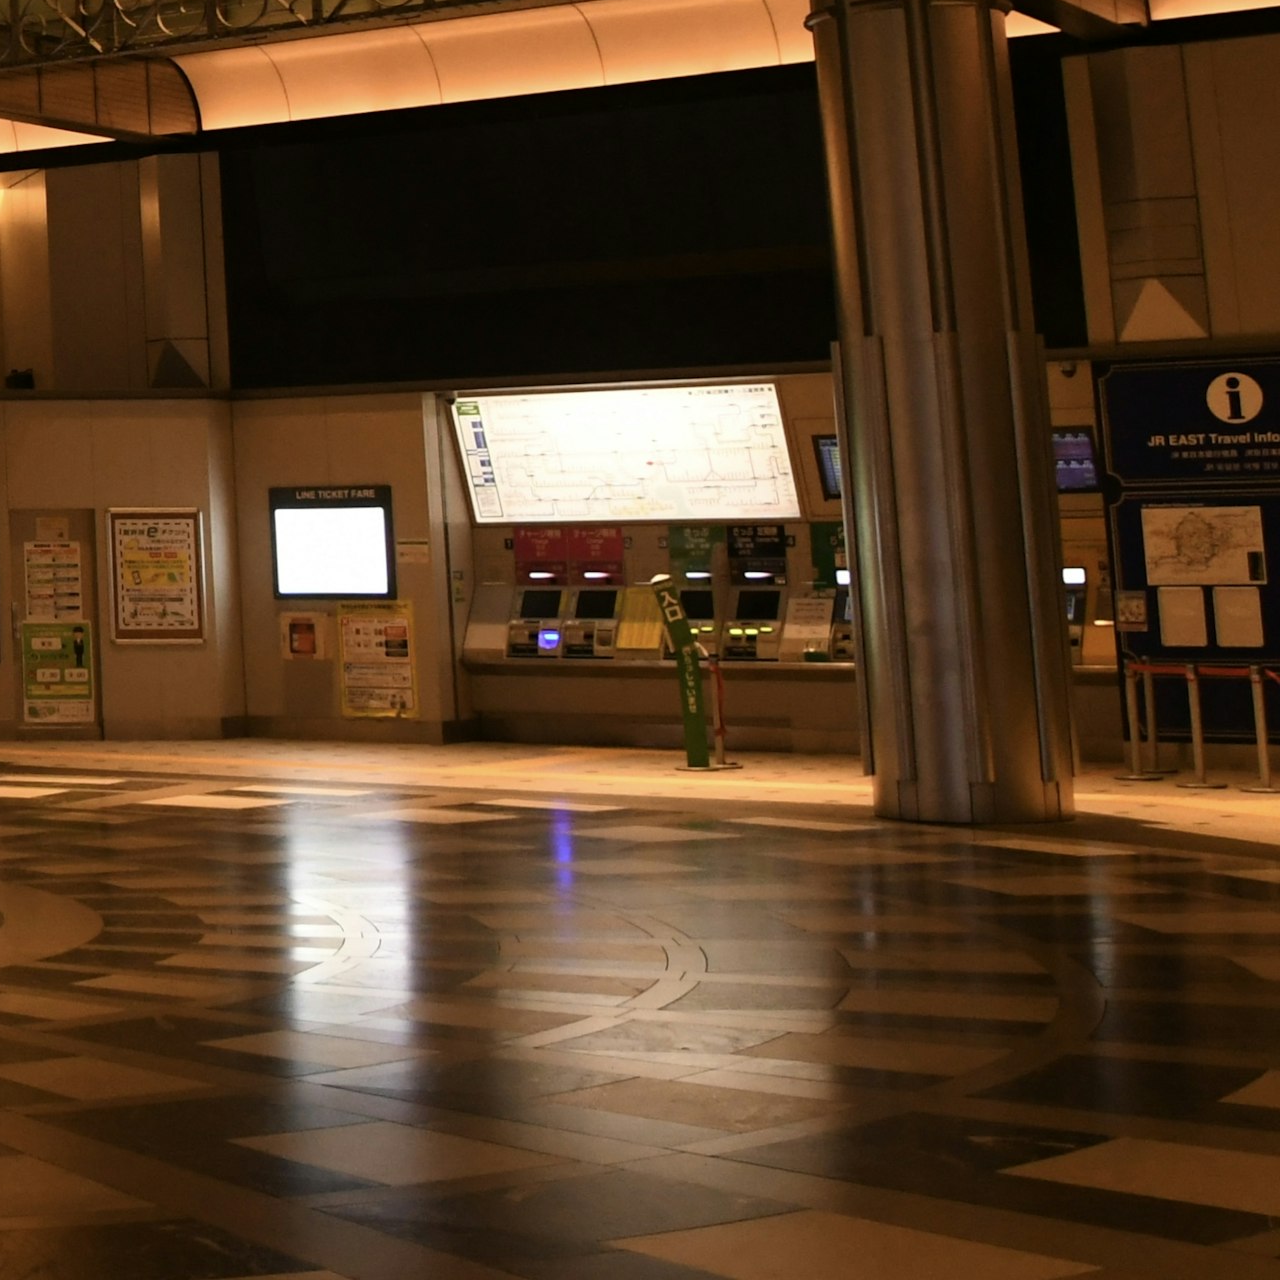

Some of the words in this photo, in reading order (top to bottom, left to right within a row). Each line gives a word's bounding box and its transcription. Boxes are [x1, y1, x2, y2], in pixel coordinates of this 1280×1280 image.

[1148, 435, 1165, 447] JR
[1169, 434, 1206, 446] EAST
[1209, 433, 1251, 444] Travel
[295, 491, 316, 500] LINE
[318, 490, 349, 499] TICKET
[350, 489, 376, 499] FARE
[659, 591, 683, 623] 入口
